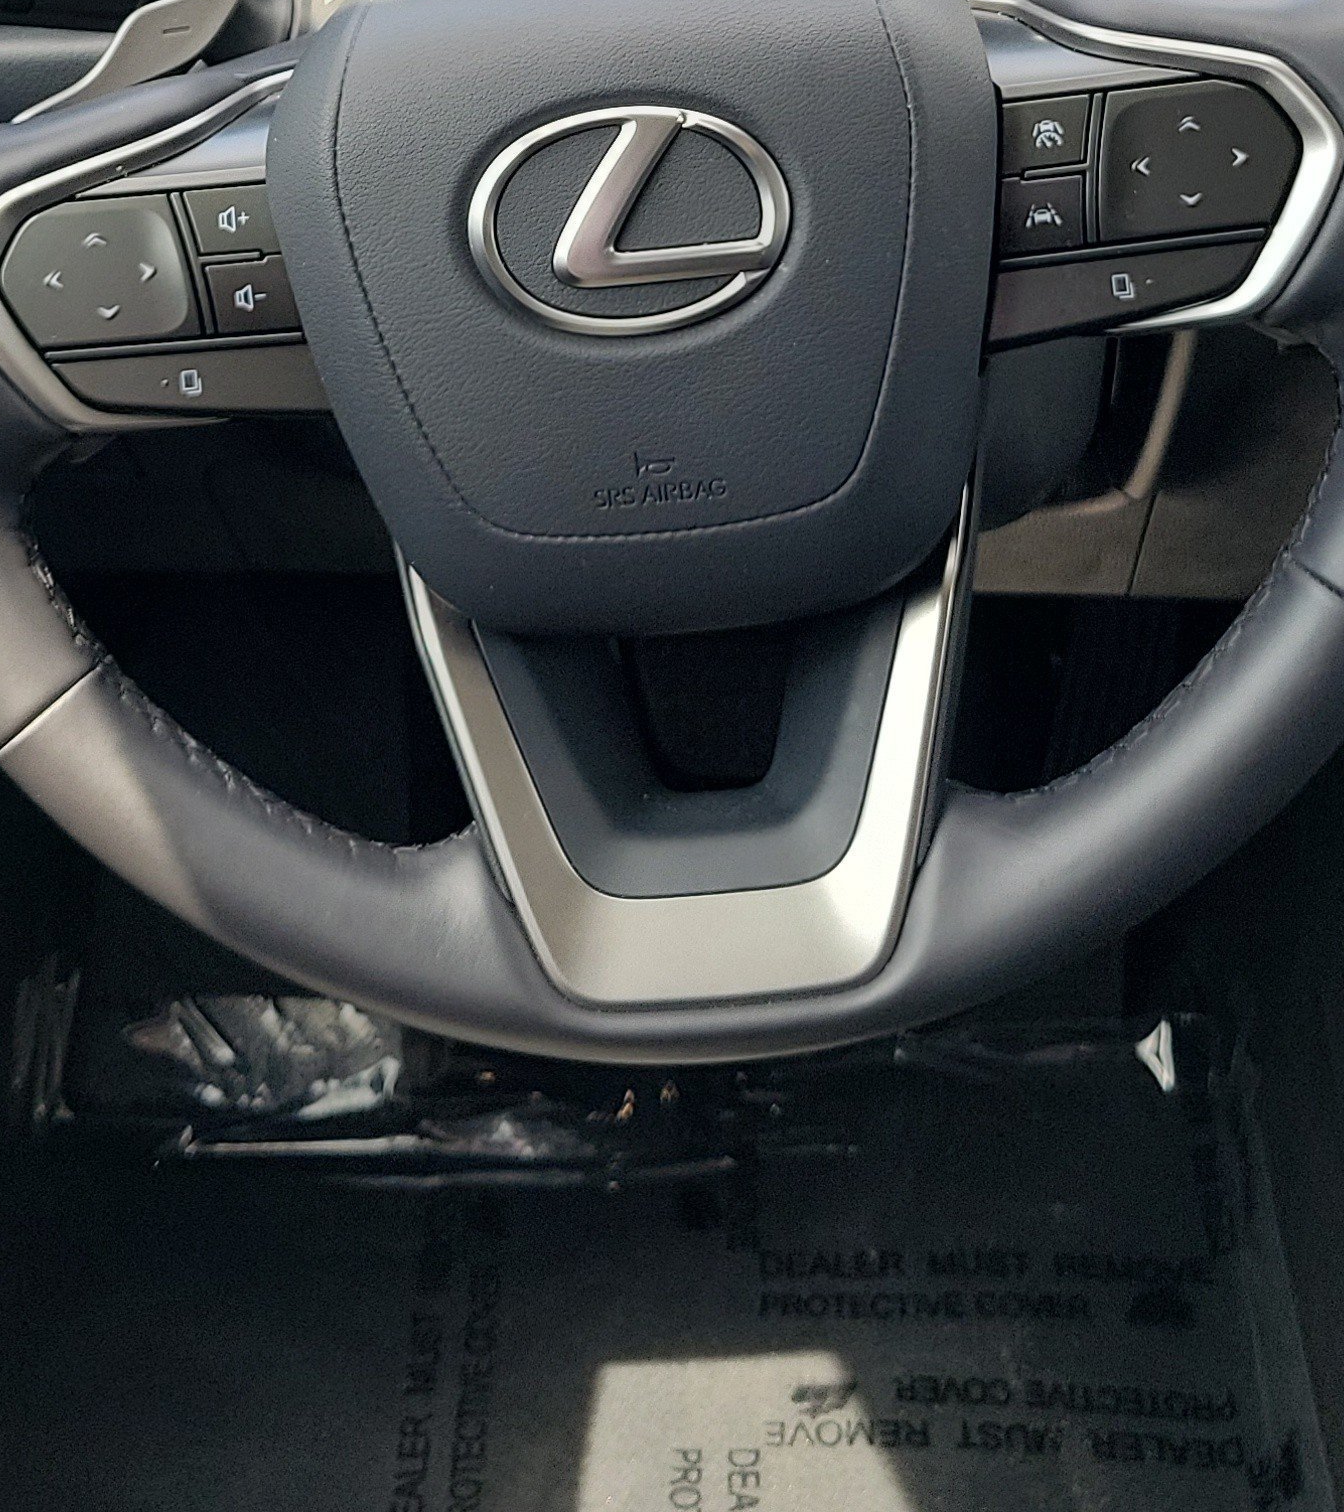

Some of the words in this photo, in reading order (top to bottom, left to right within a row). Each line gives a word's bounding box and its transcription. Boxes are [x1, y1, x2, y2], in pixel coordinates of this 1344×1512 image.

[594, 486, 636, 509] SRS
[642, 477, 728, 505] AIRBAG
[760, 1250, 904, 1278] DEALER
[928, 1250, 1029, 1277] MUST
[759, 1291, 967, 1319] PROTECTIVE
[896, 1374, 1010, 1406] COVER
[765, 1419, 931, 1448] REMOVE
[669, 1448, 704, 1512] PRO
